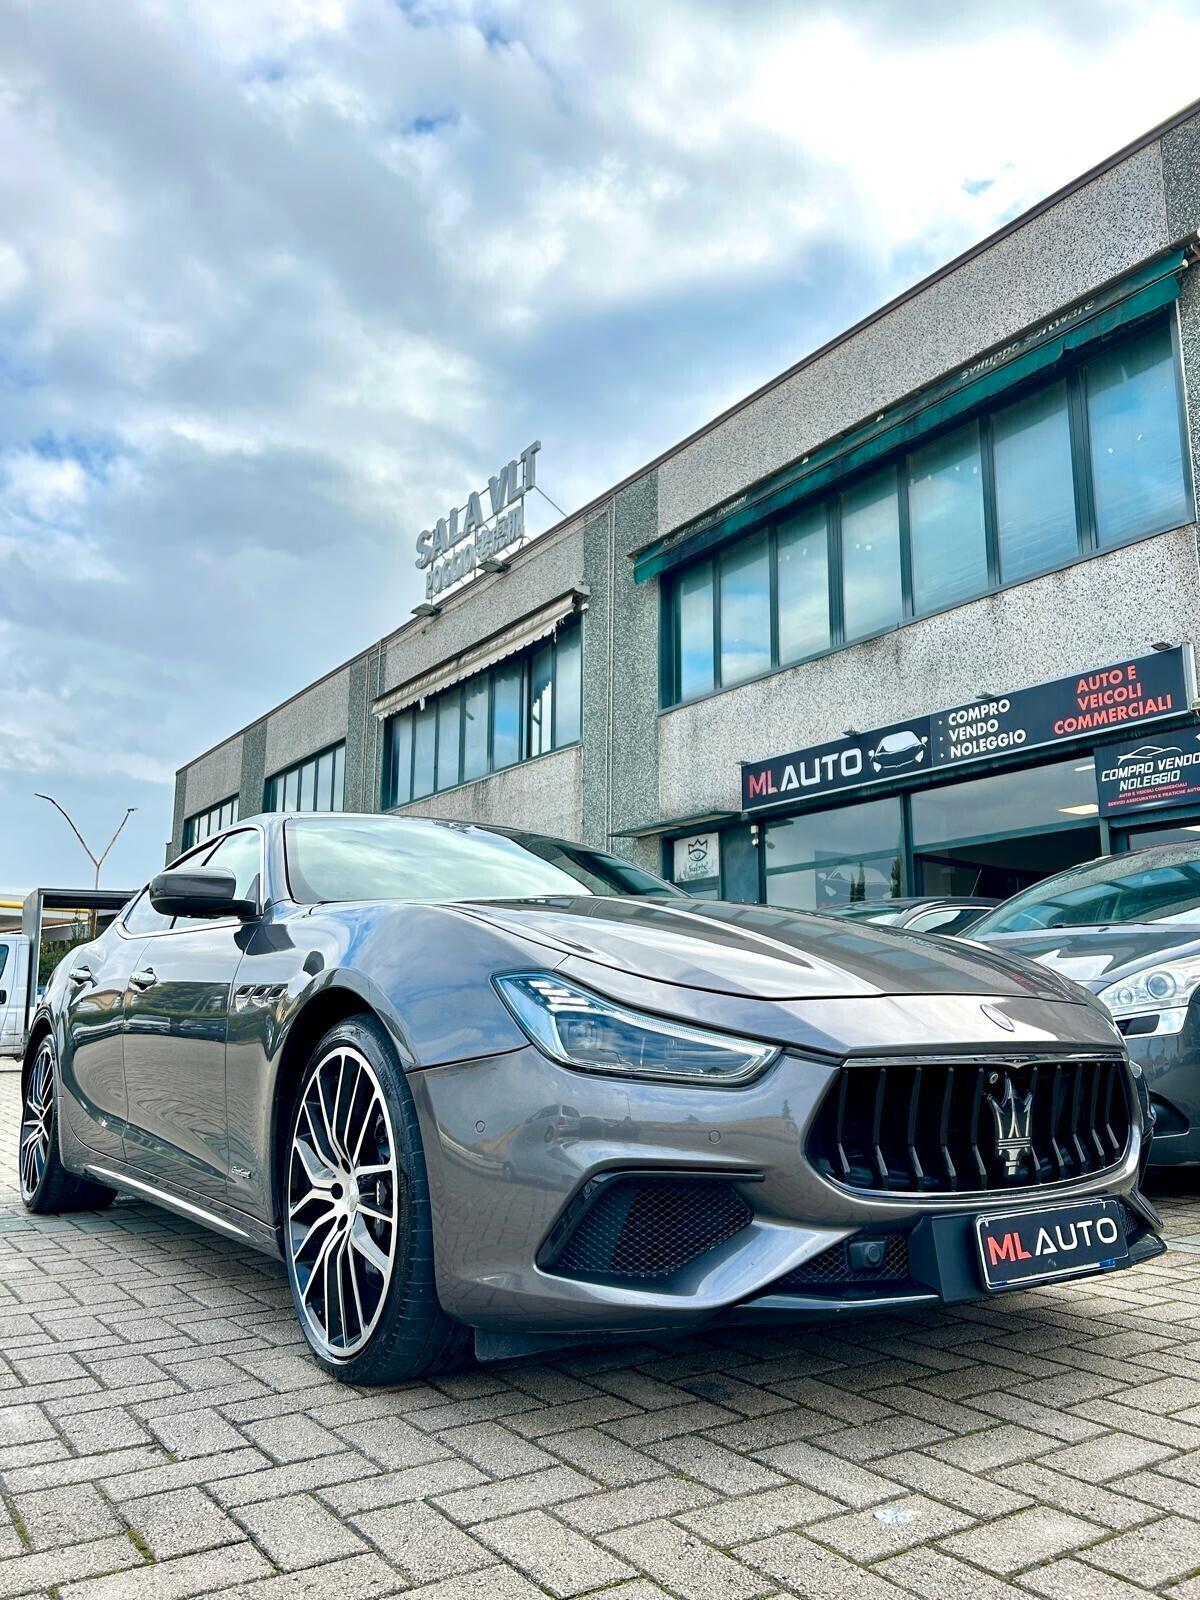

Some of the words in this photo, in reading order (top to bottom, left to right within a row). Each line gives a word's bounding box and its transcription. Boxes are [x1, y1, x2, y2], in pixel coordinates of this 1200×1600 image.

[960, 342, 1019, 380] Sviluppo
[415, 490, 485, 570] SALA
[488, 440, 541, 516] VLT
[1077, 668, 1123, 694] AUTO
[1127, 665, 1136, 680] E
[1077, 682, 1142, 712] VEICOLI
[949, 699, 1011, 726] COMPRO
[1054, 694, 1172, 735] COMMERCIALI
[949, 719, 999, 743] VENDO
[950, 729, 1027, 759] NOLEGGIO
[1101, 762, 1153, 782] COMPRO
[1158, 752, 1200, 771] VENDO
[1120, 770, 1180, 791] NOLEGGIO
